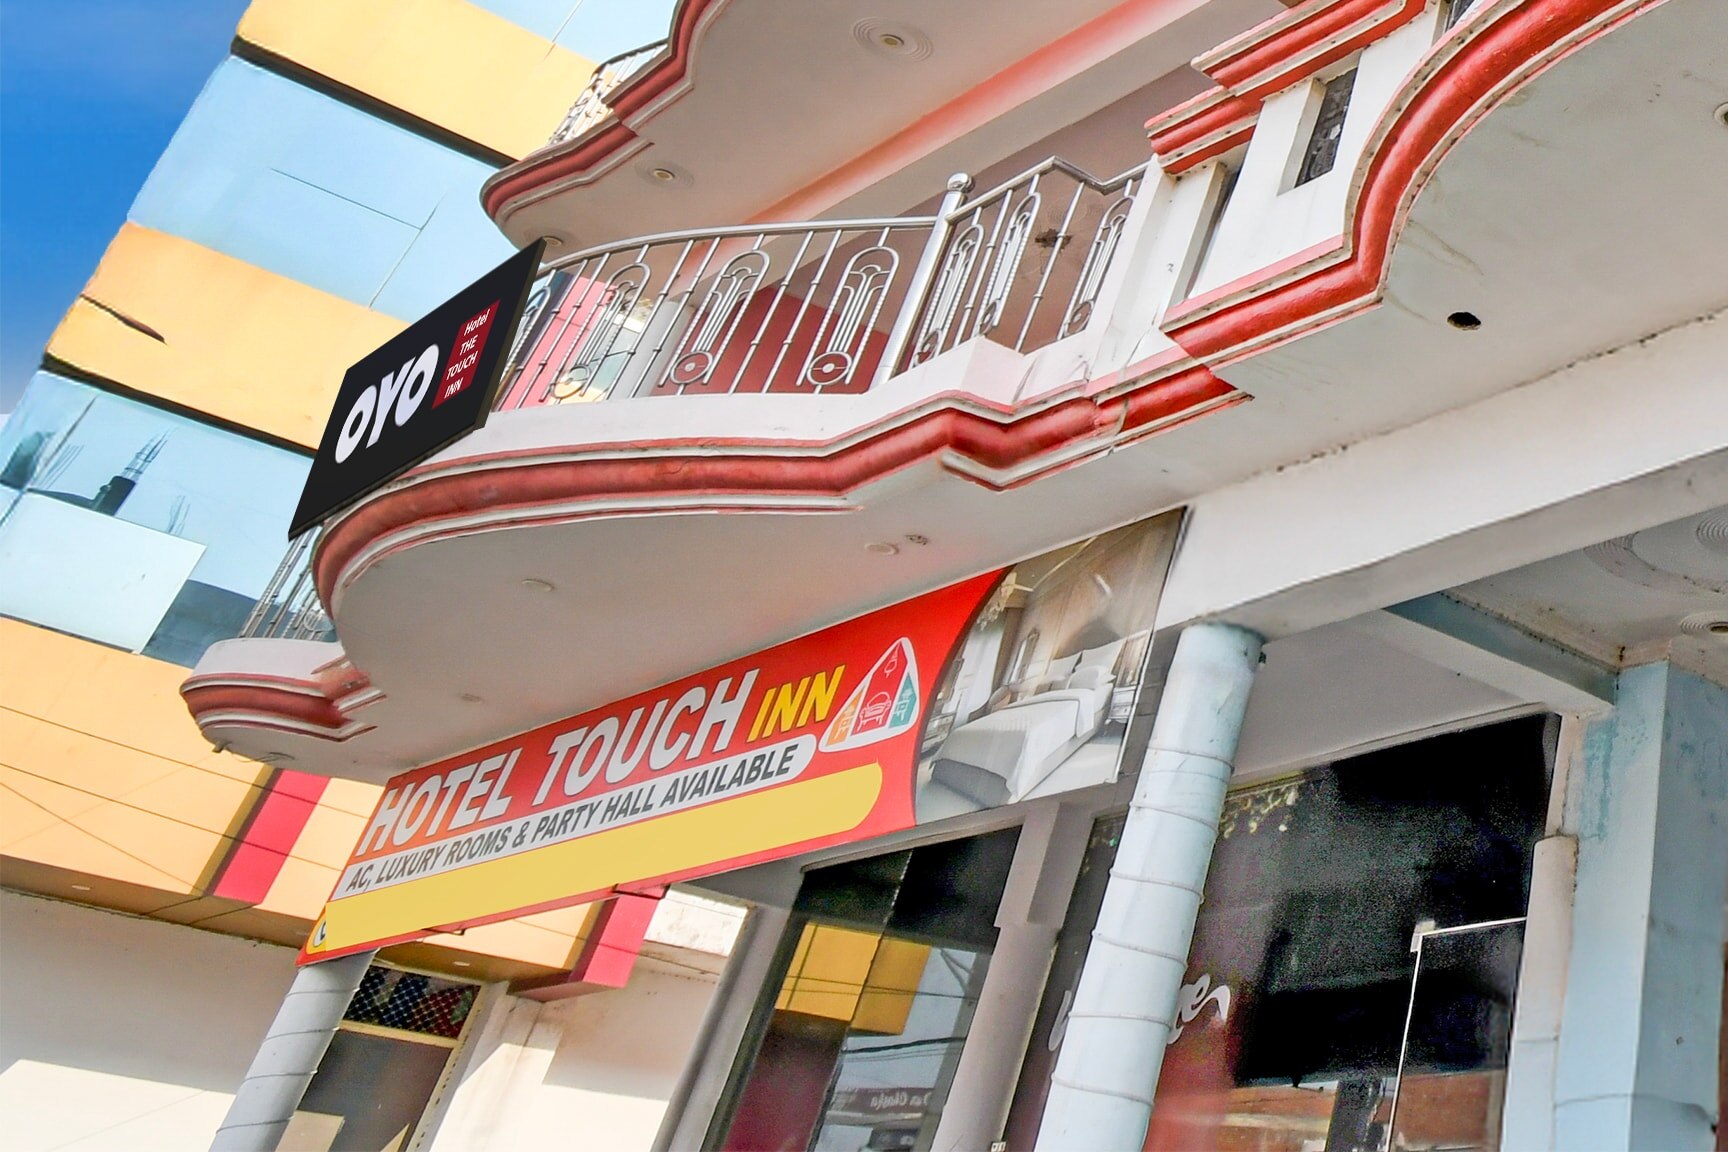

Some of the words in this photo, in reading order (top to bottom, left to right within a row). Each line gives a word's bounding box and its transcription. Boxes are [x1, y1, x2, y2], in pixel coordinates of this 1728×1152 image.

[464, 308, 490, 336] Hotel
[460, 335, 478, 355] THE
[446, 351, 478, 380] TOUCH
[444, 377, 463, 398] INN
[335, 343, 440, 464] OYO
[355, 748, 522, 857] HOTEL
[532, 668, 760, 805] TOUCH
[746, 664, 846, 743] INN
[346, 864, 374, 892] AC,
[375, 844, 447, 885] LUXURY
[443, 829, 509, 867] ROOMS
[512, 821, 530, 847] &
[530, 801, 601, 844] PARTY
[600, 785, 656, 825] HALL
[660, 744, 799, 808] AVAILABLE
